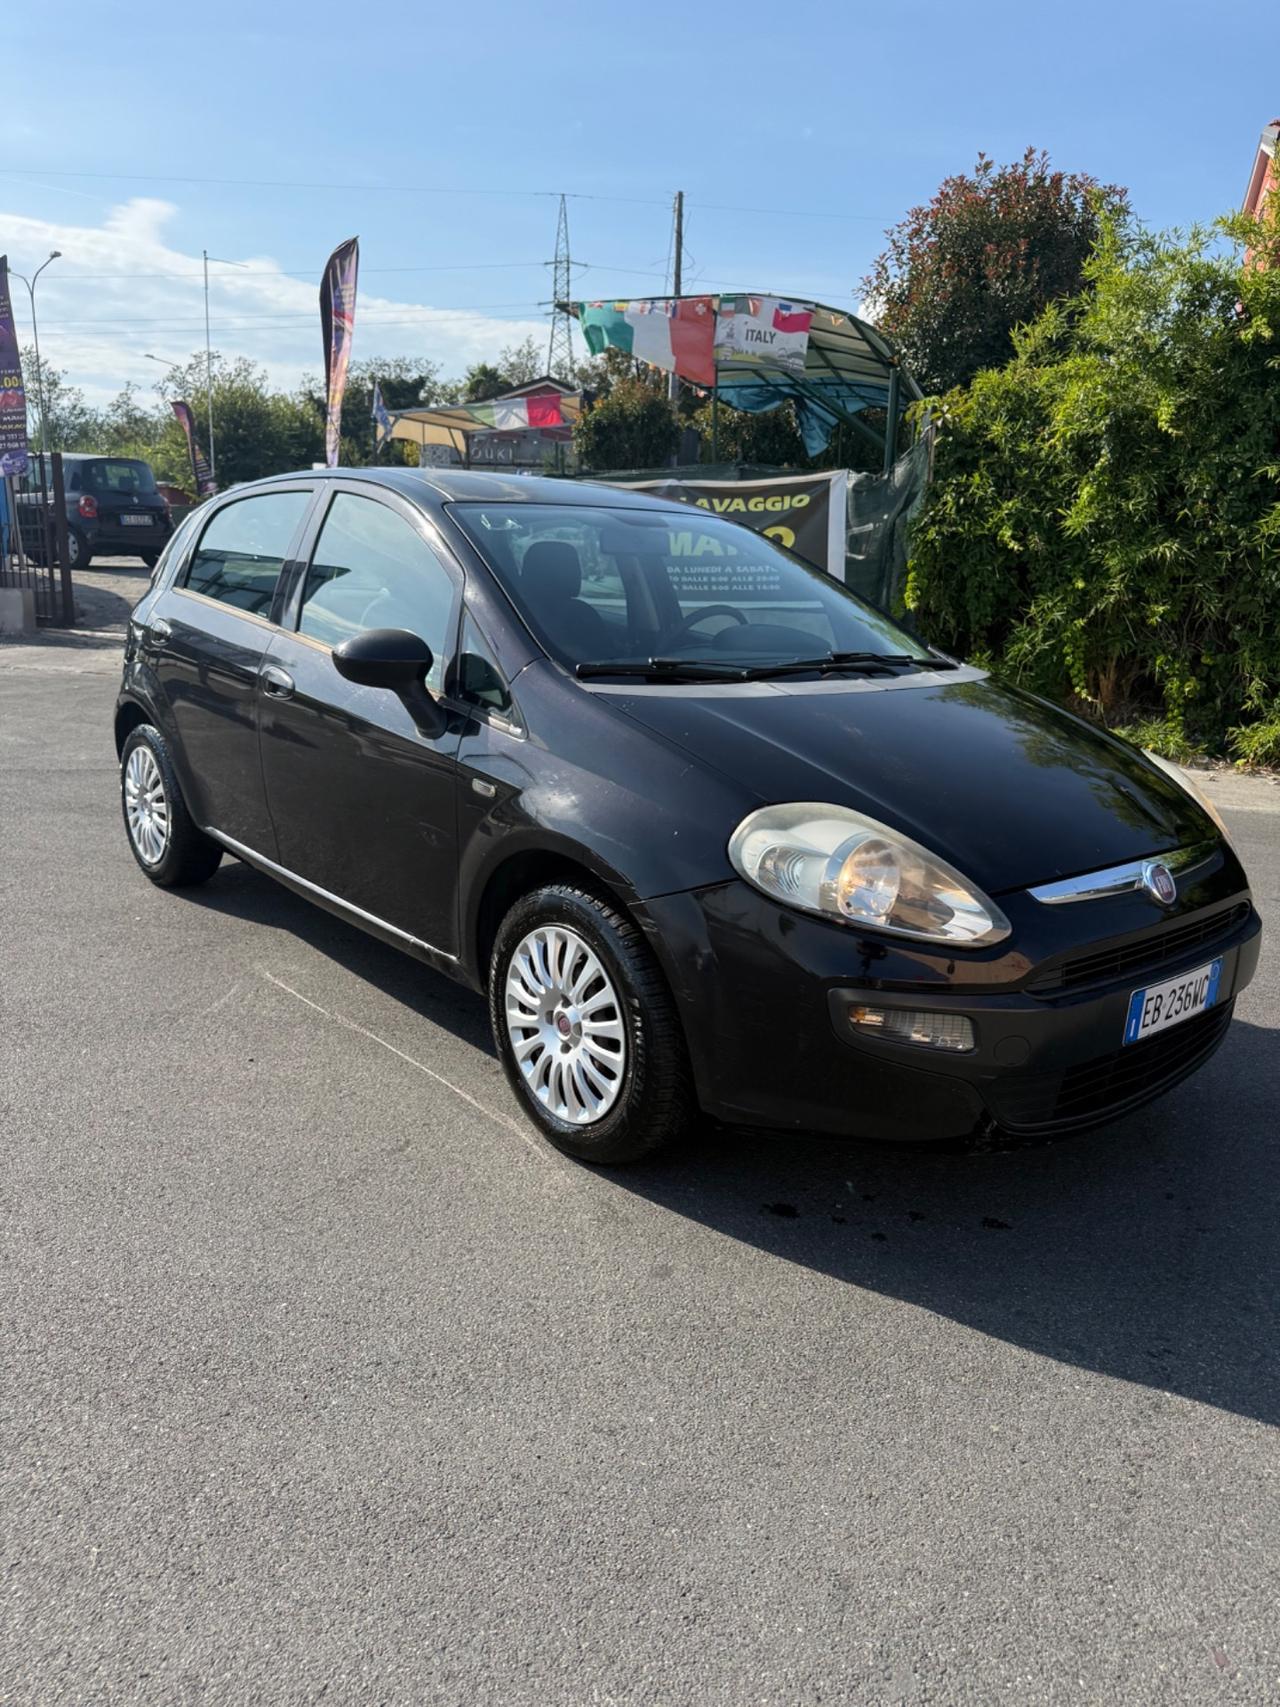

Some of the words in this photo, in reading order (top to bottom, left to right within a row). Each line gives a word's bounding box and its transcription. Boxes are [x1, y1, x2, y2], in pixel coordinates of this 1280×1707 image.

[745, 328, 777, 344] ITALY
[679, 493, 811, 513] AVAGGIO
[1141, 993, 1163, 1029] EB
[1165, 974, 1209, 1020] 236WC
